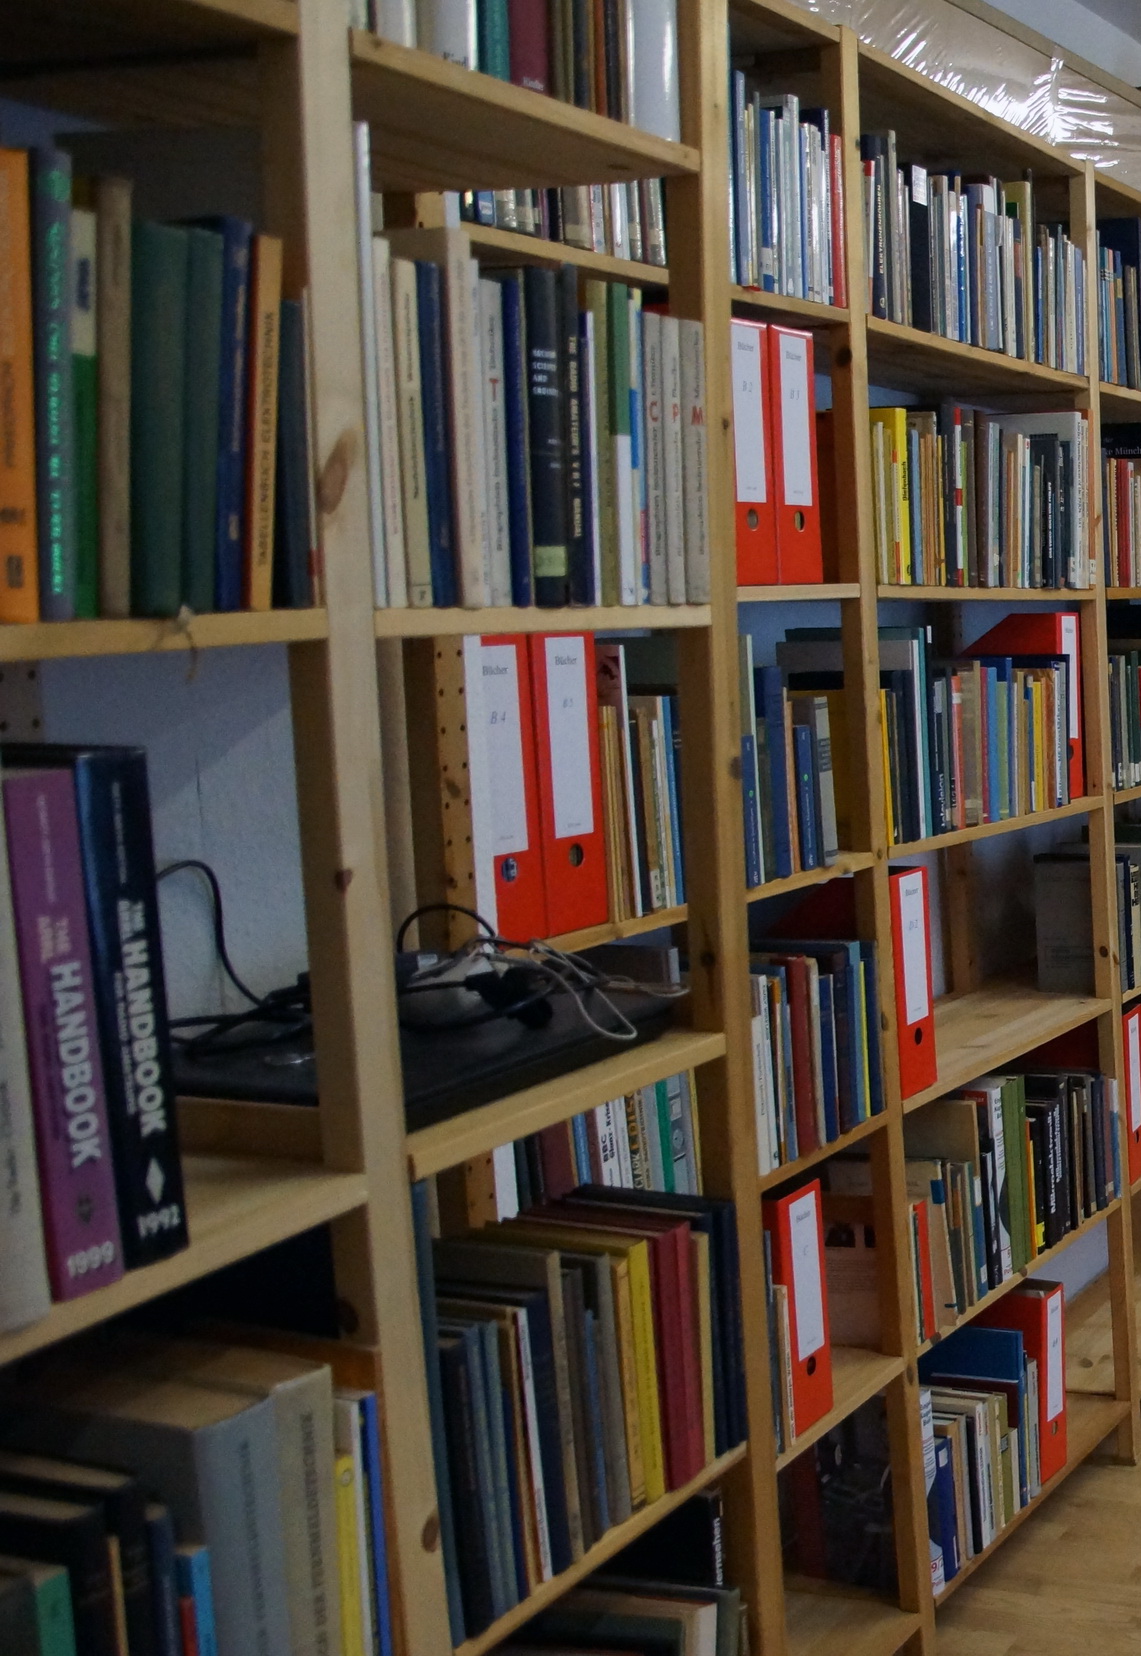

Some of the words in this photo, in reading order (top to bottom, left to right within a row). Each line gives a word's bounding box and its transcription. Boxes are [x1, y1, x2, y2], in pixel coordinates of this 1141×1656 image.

[567, 336, 578, 354] THE
[569, 361, 579, 393] RADIO
[649, 401, 659, 423] C
[690, 405, 703, 426] M
[482, 665, 509, 677] Bücher
[554, 656, 577, 667] Bücher
[490, 711, 498, 725] B
[117, 899, 135, 944] ARRL
[131, 900, 146, 932] THE
[37, 915, 56, 964] ARRL
[53, 917, 72, 954] THE
[121, 938, 168, 1138] HANDBOOK
[49, 960, 104, 1169] HANDBOOK
[600, 1134, 609, 1163] BBC
[1047, 1111, 1057, 1214] Mikroelektronik
[631, 1152, 644, 1189] CLARK
[136, 1203, 182, 1239] 1992
[67, 1240, 114, 1279] 1999
